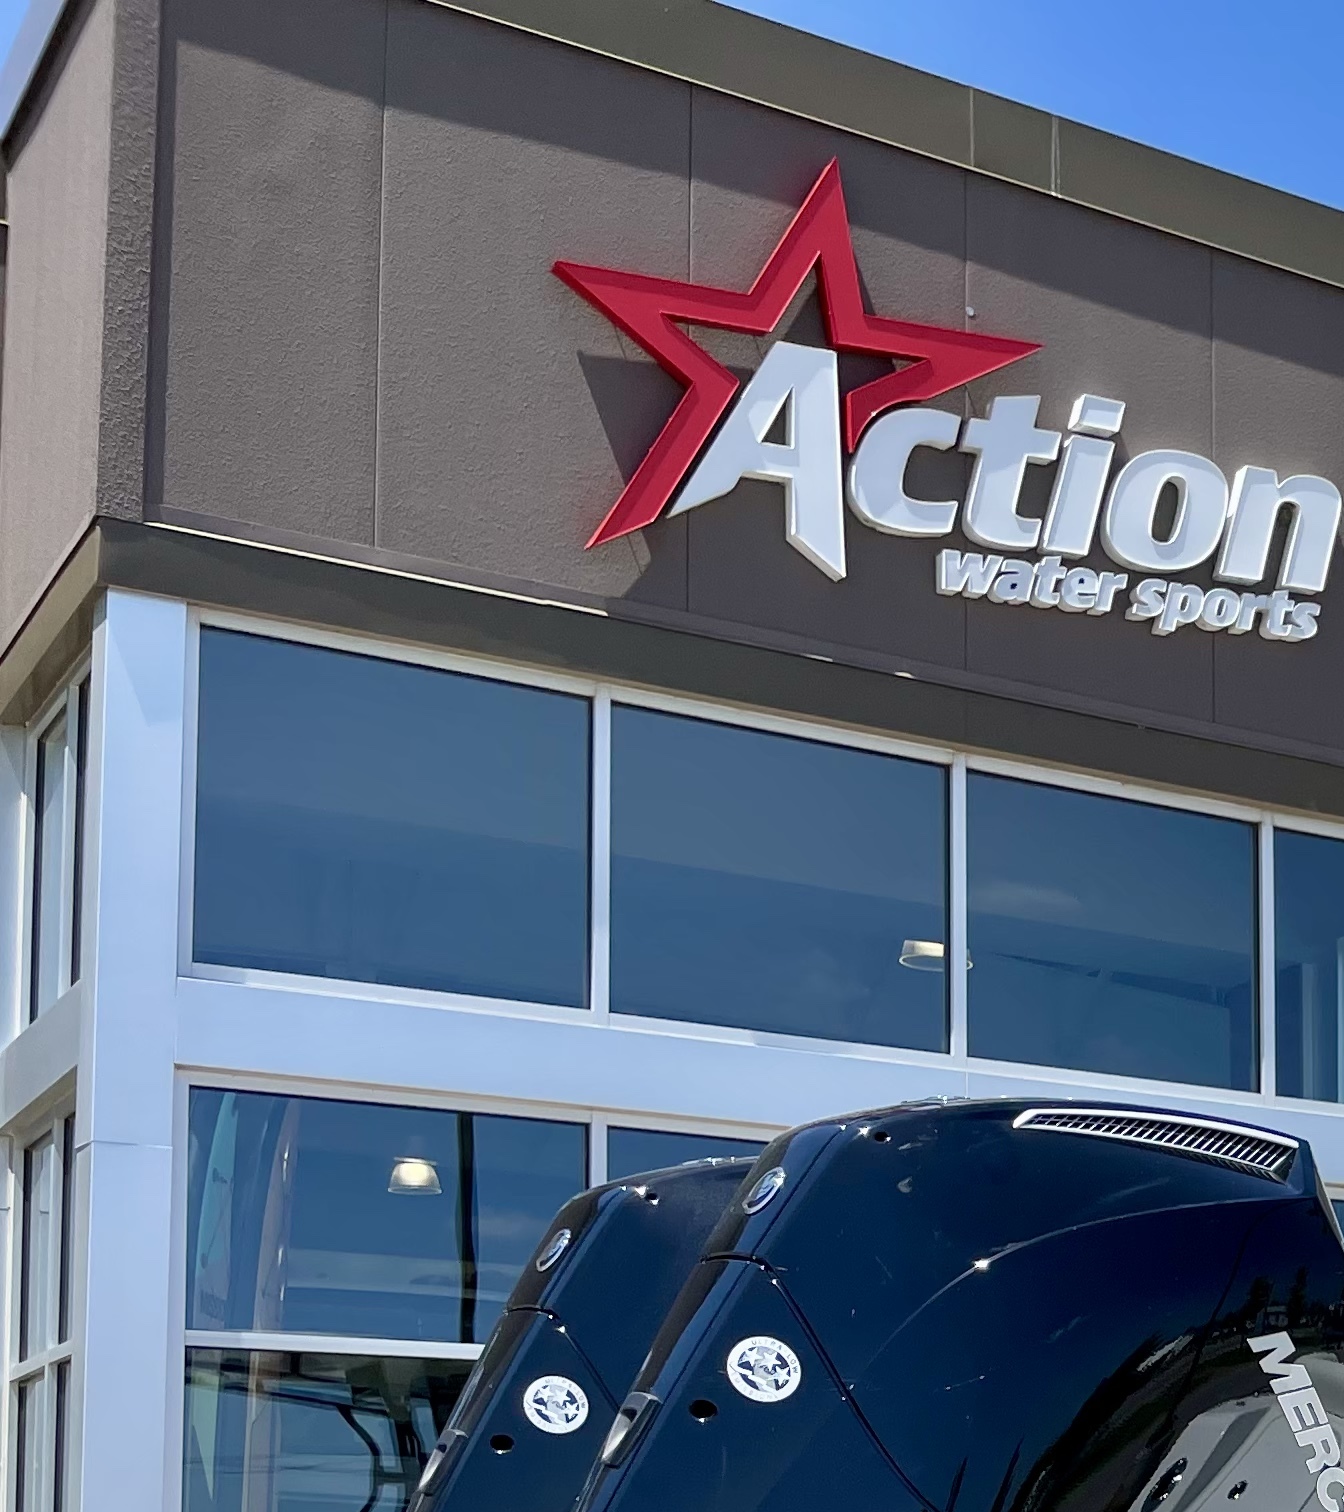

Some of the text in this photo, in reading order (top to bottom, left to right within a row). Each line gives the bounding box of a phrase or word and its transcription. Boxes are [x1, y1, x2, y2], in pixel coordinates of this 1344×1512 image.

[668, 340, 1344, 583] Action
[935, 549, 1322, 641] water sports
